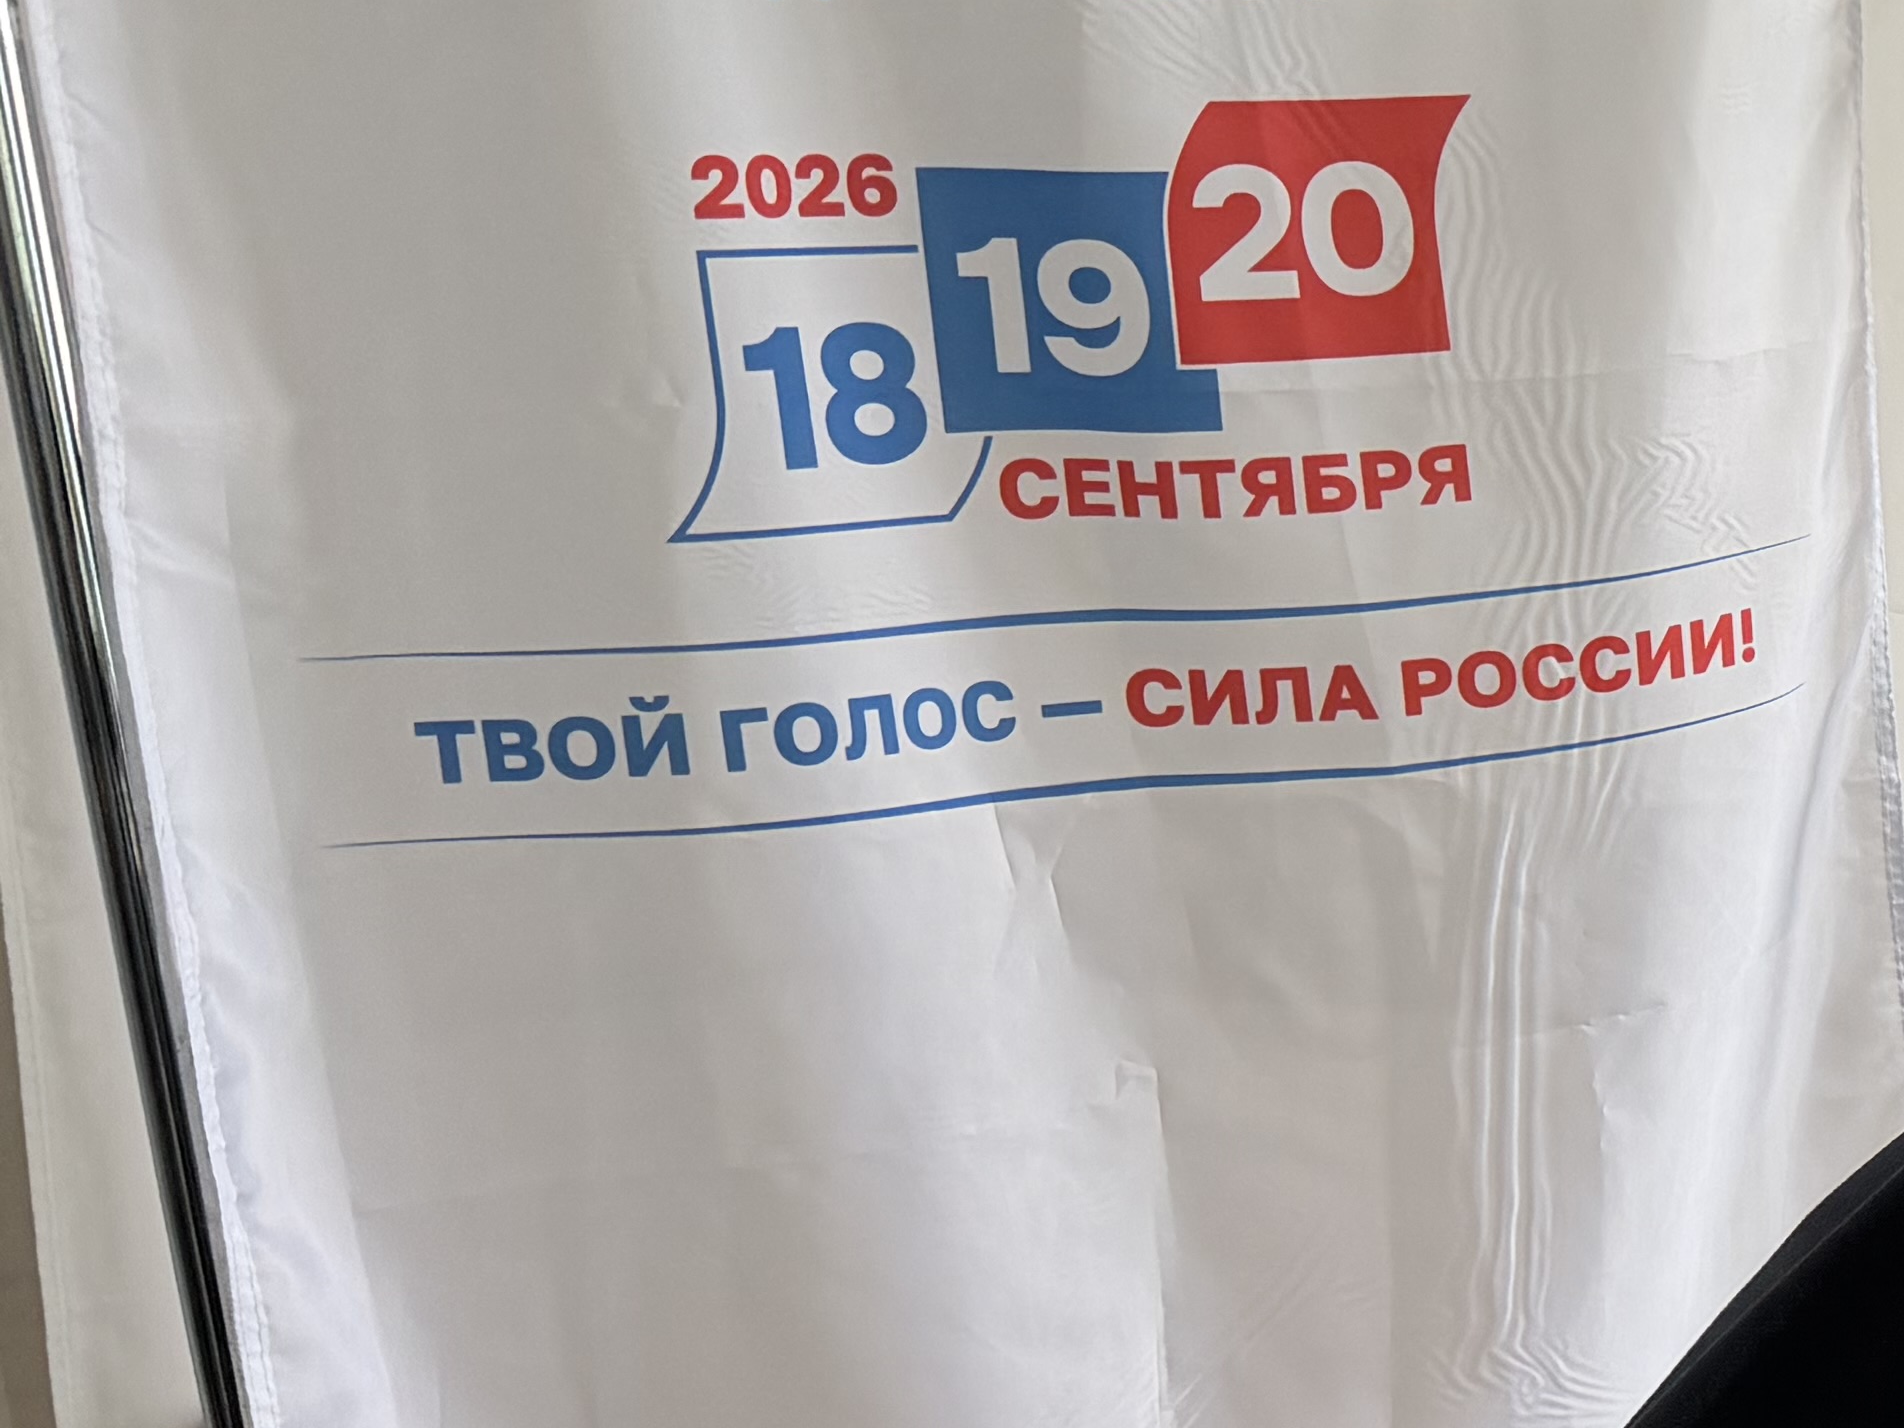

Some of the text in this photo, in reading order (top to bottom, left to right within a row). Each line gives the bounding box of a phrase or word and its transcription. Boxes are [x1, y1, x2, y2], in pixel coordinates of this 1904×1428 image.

[691, 154, 898, 220] 2026
[1191, 162, 1415, 302] 20
[955, 237, 1153, 377] 19
[741, 320, 929, 472] 18
[998, 444, 1471, 520] СЕНТЯБРЯ
[415, 697, 688, 782] ТВОЙ
[721, 679, 1015, 775] ГОЛОС
[1125, 664, 1379, 730] СИЛА
[1402, 607, 1758, 717] РОССИИ!
